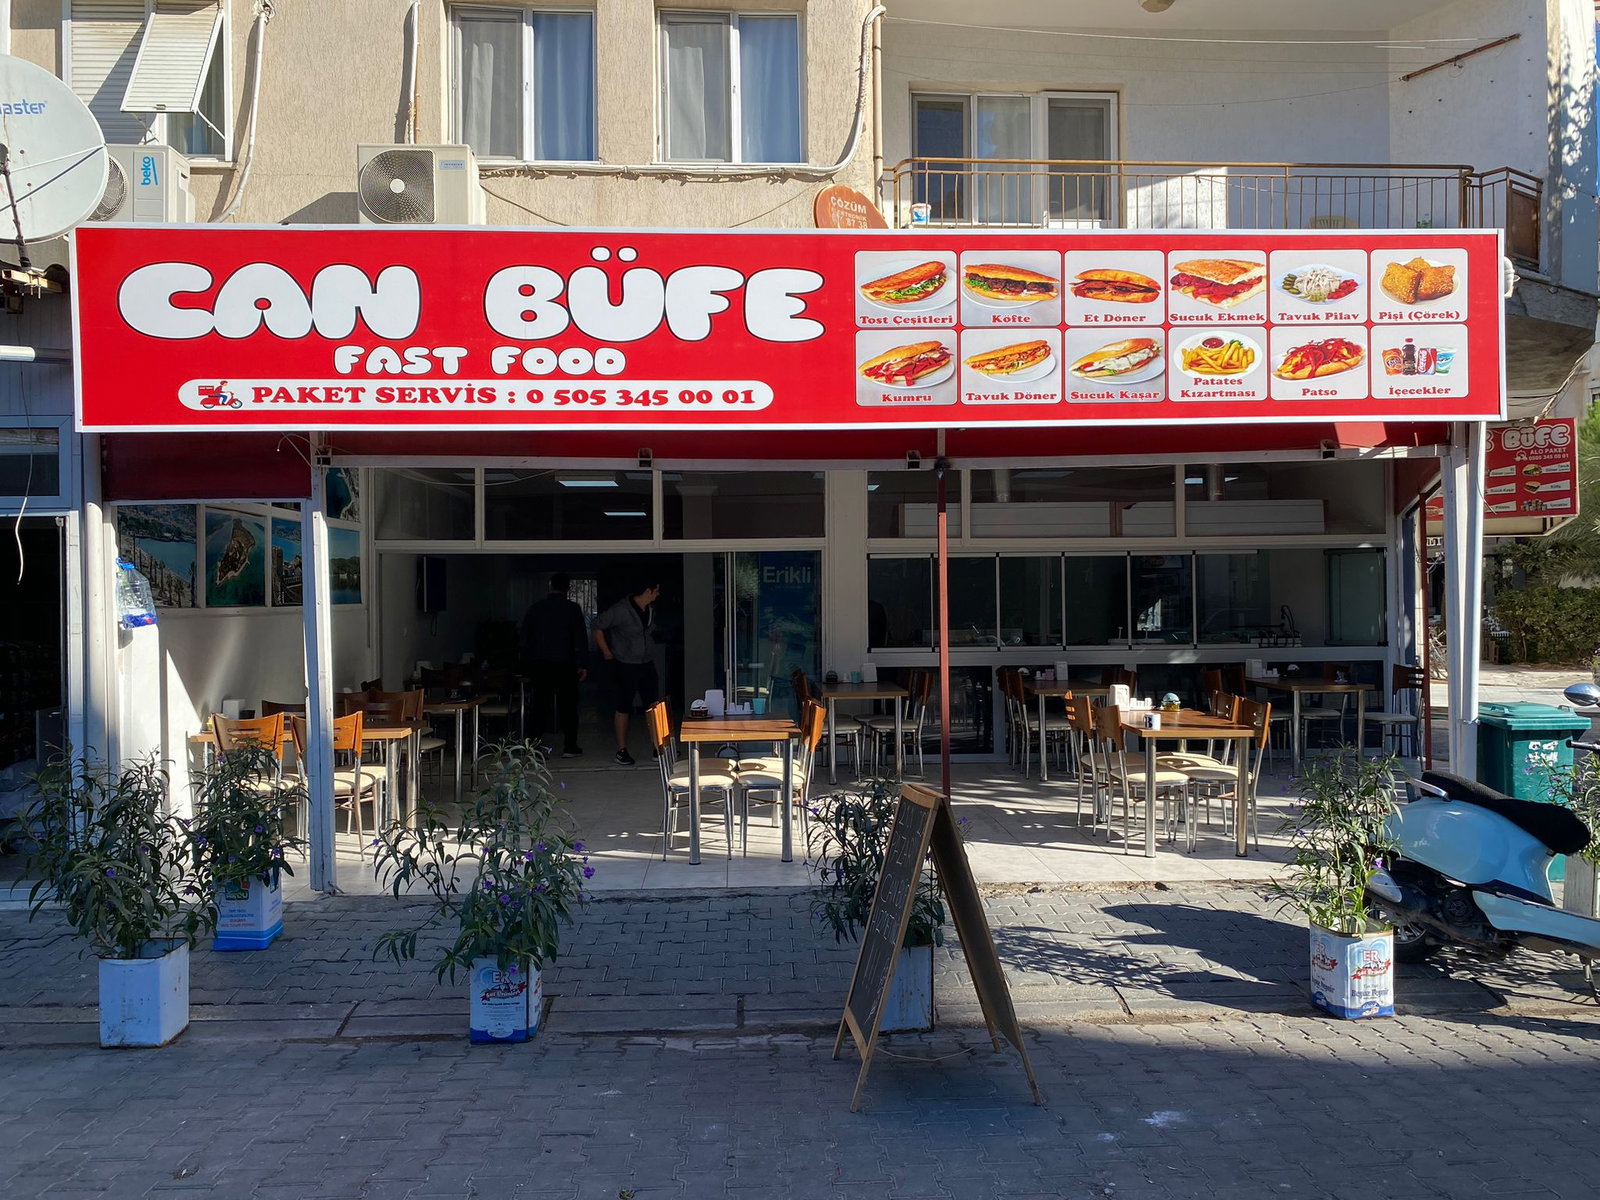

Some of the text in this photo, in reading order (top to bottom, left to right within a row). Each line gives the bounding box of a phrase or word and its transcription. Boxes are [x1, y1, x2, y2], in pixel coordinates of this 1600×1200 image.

[0, 99, 45, 114] aster
[141, 156, 151, 186] beko
[830, 196, 867, 214] ÇÖZÜM
[117, 246, 825, 342] CAN BÜFE
[860, 314, 954, 327] Tost Çeşitleri
[991, 314, 1031, 324] Köfte
[1083, 313, 1147, 323] Et Döner
[1169, 312, 1265, 322] Sucuk Ekmek
[1278, 312, 1361, 321] Tavuk Pilav
[1378, 310, 1461, 322] Pişi (Çörek)
[334, 345, 626, 375] FAST FOOD
[1193, 377, 1243, 386] Patates
[251, 383, 756, 407] PAKET SERVİS : 0 505 345 00 01
[966, 391, 1057, 401] Tavuk Döner
[1070, 391, 1160, 401] Sucuk Kaşar
[1180, 389, 1256, 398] Kızartması
[1301, 387, 1338, 396] Patso
[1388, 386, 1451, 397] İçecekler
[882, 393, 932, 403] Kumru
[1502, 424, 1571, 451] BÜFE
[763, 566, 811, 584] Erikli
[1363, 950, 1379, 962] ER
